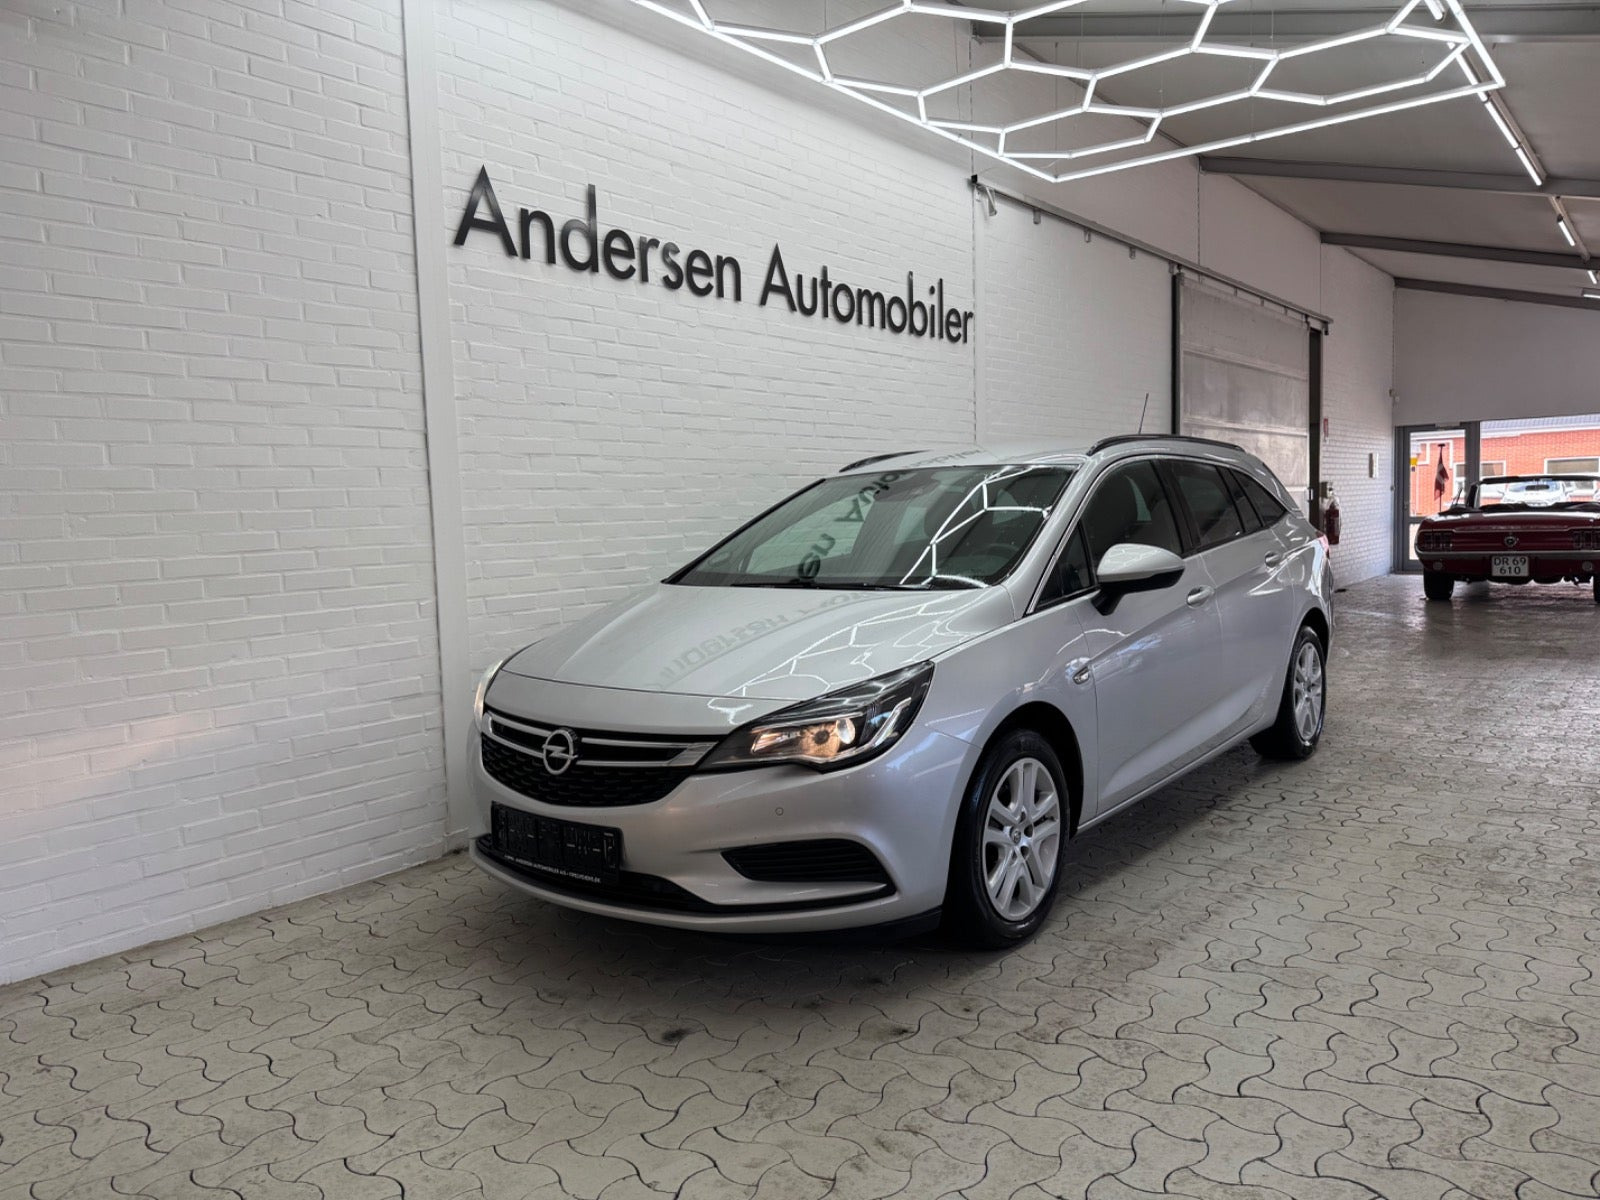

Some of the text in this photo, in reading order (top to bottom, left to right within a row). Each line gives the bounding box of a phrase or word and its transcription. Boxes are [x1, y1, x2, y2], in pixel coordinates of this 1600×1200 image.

[453, 164, 974, 345] Andersen Automobiler
[1494, 557, 1527, 566] DR 69
[1500, 566, 1521, 575] 610
